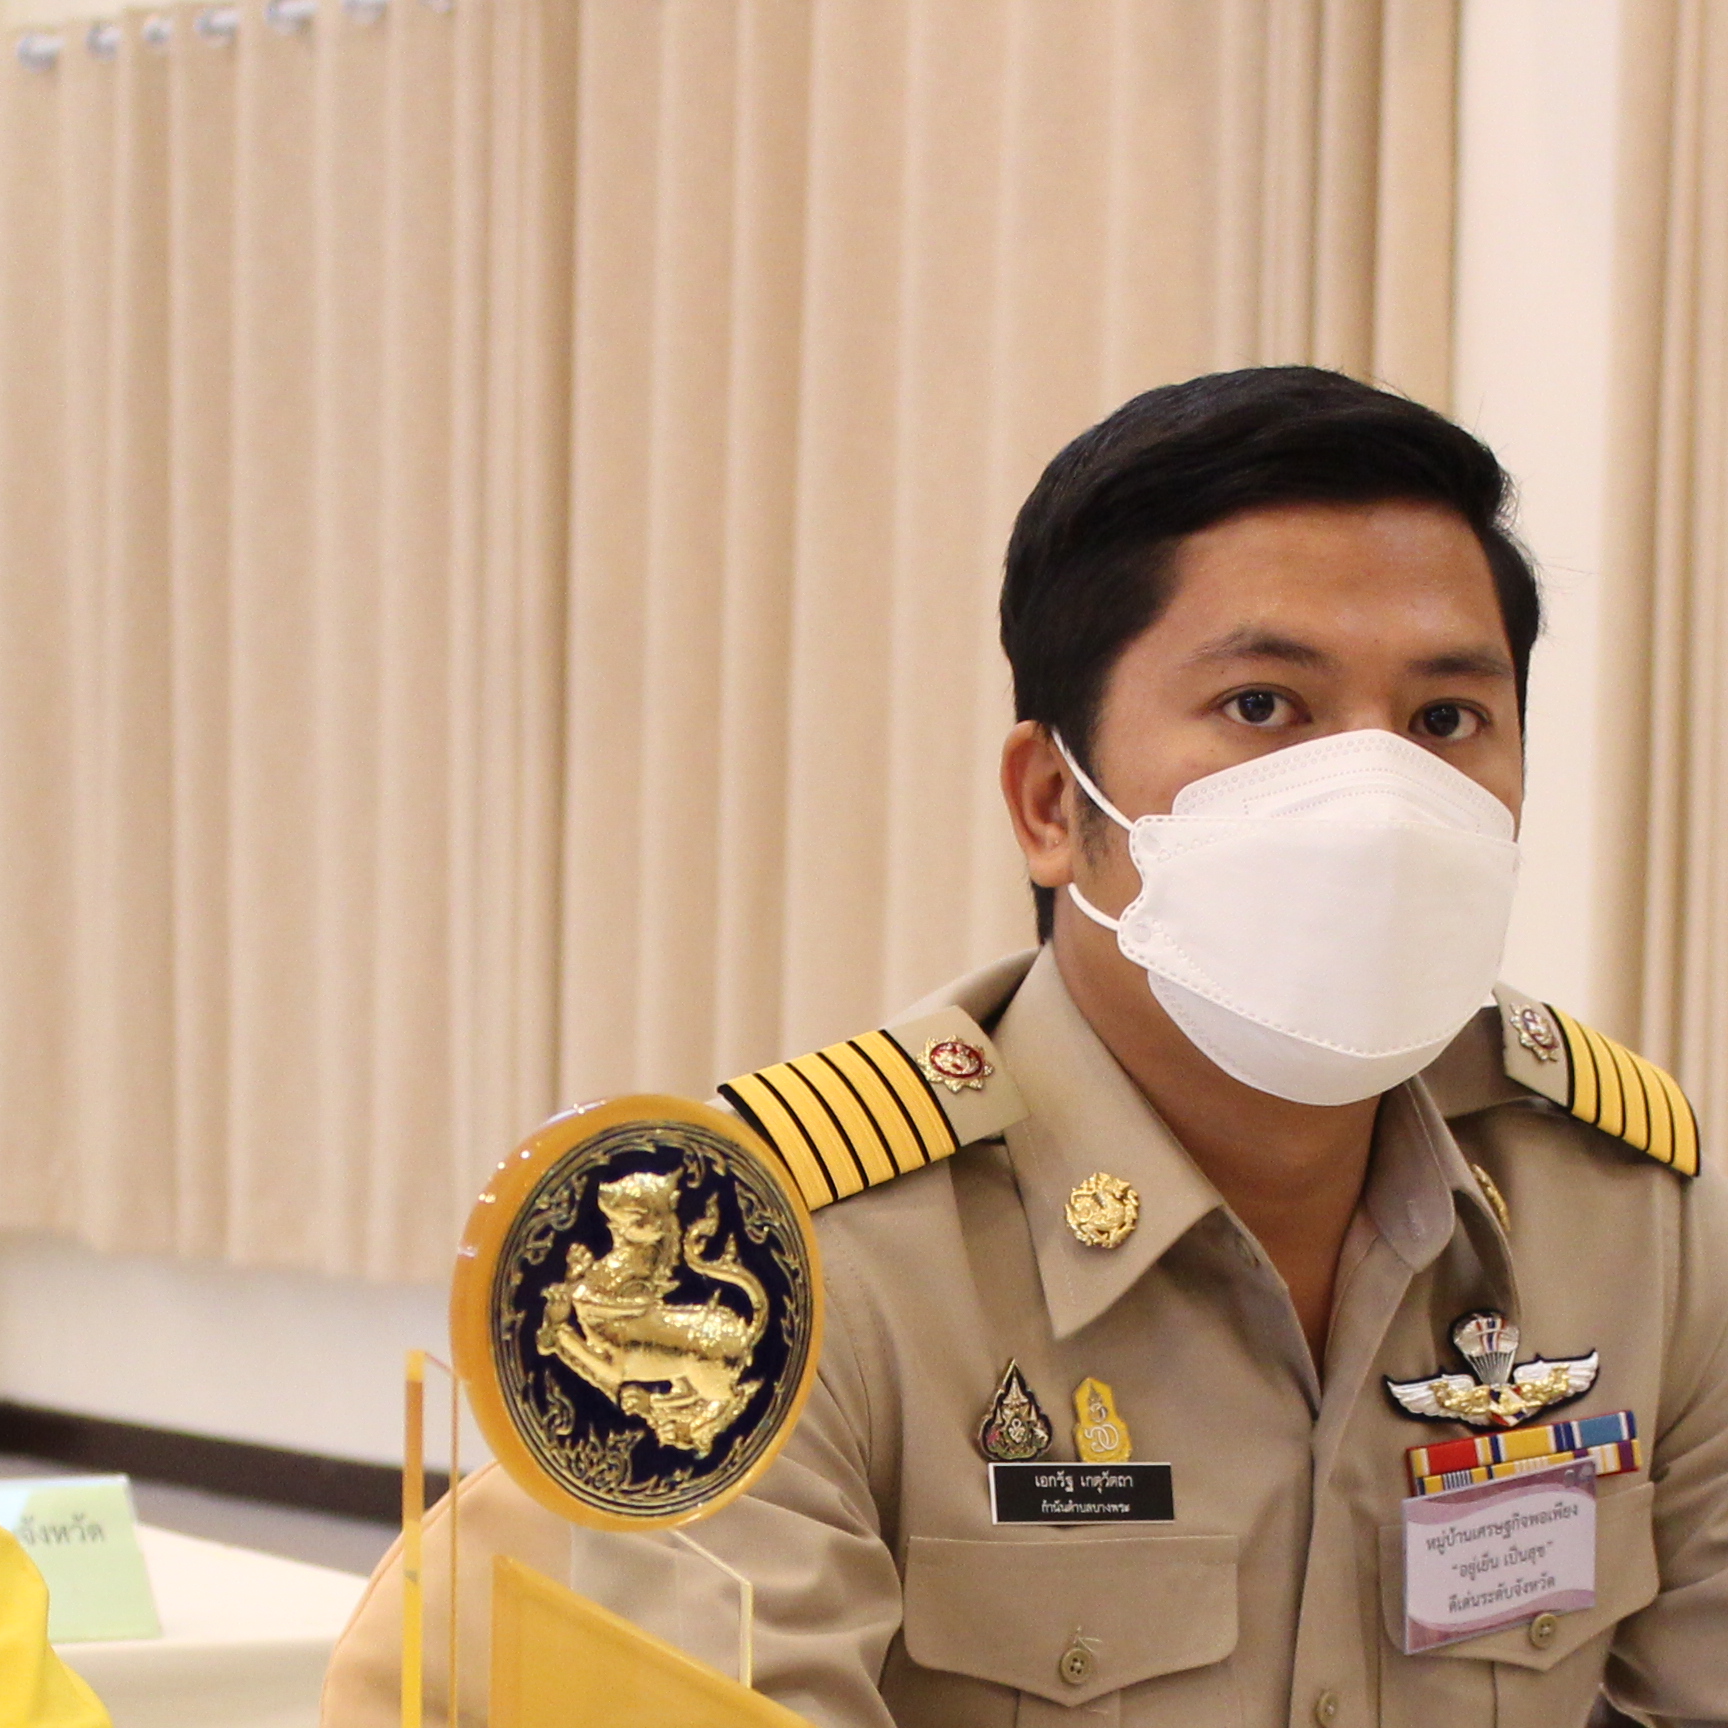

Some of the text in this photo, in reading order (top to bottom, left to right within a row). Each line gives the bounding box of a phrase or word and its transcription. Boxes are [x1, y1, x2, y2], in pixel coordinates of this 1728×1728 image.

[1035, 1470, 1075, 1493] เอกรัฐ
[1426, 1500, 1579, 1553] หมู่บ้านเศรษฐกิจพอเพียง
[1448, 1572, 1556, 1614] ดีเด่นระดับจังหวัด
